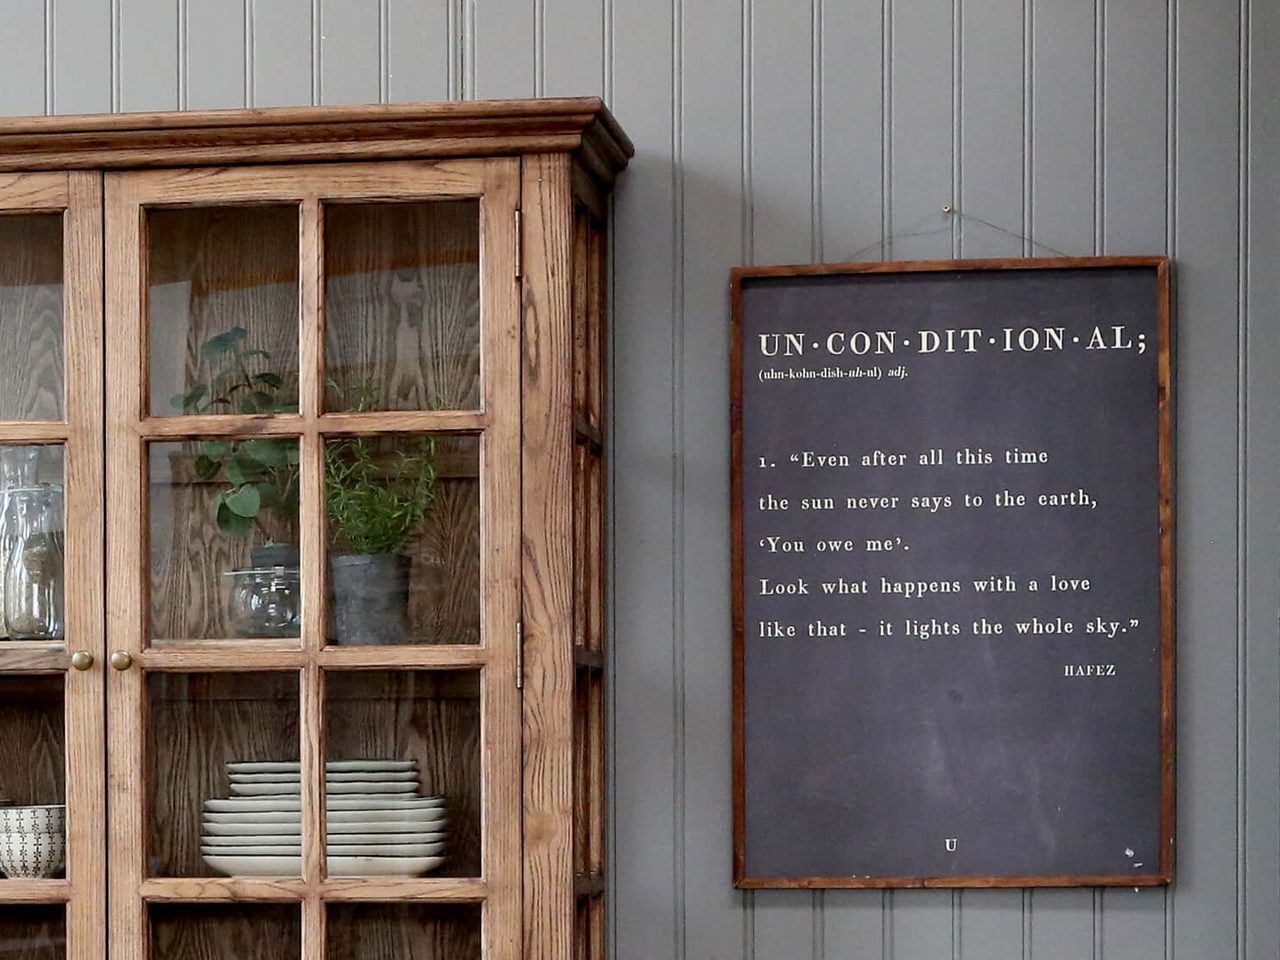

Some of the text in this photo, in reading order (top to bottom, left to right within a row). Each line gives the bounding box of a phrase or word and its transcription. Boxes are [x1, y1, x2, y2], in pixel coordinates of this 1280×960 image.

[887, 365, 909, 380] adj.
[758, 457, 776, 468] 1.
[861, 450, 907, 466] after
[919, 448, 943, 466] all
[956, 448, 993, 465] this
[1005, 447, 1048, 464] time
[759, 488, 1097, 513] the sun never says to the earth,
[816, 540, 854, 552] owe
[759, 574, 1090, 599] Look what happens with a love
[759, 620, 796, 638] like
[808, 620, 847, 637] that
[879, 620, 893, 636] it
[905, 618, 960, 640] lights
[972, 618, 1003, 635] the
[1015, 617, 1074, 634] whole
[1064, 664, 1116, 677] HAFEZ
